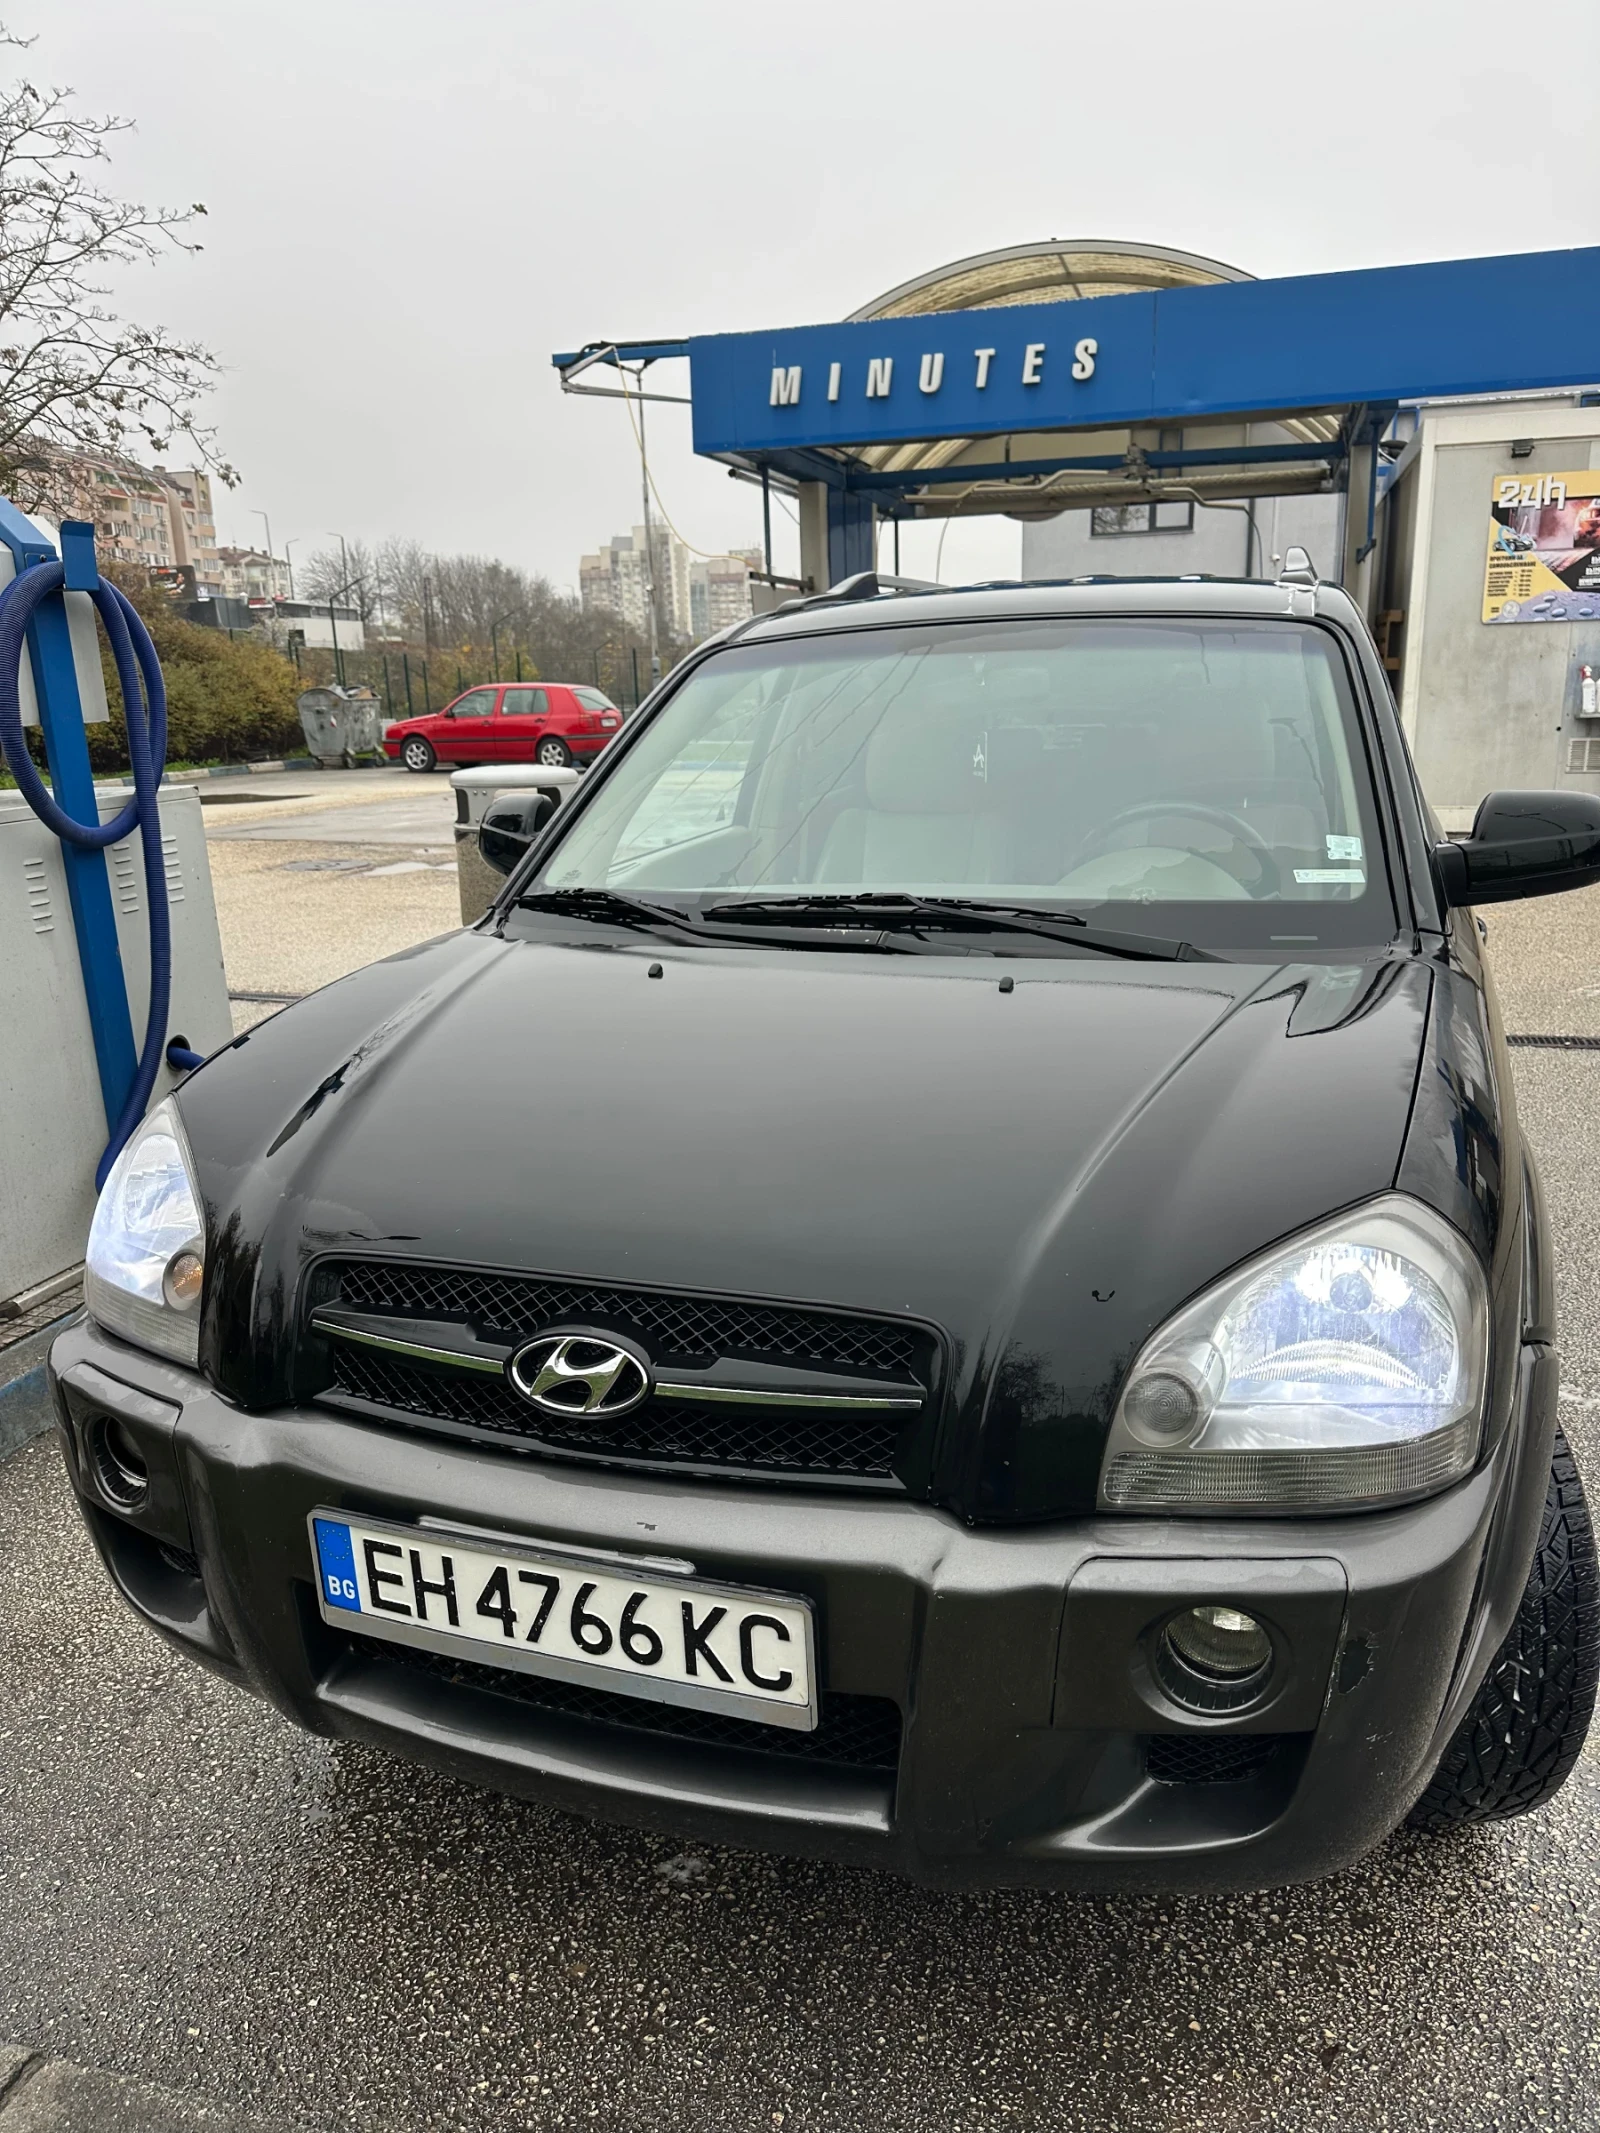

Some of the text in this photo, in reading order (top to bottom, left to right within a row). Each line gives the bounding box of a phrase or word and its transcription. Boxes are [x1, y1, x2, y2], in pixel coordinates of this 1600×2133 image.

[769, 337, 1098, 407] MINUTES
[1498, 475, 1566, 509] 24h
[327, 1573, 356, 1601] BG
[363, 1538, 793, 1692] EH 4766 KC
